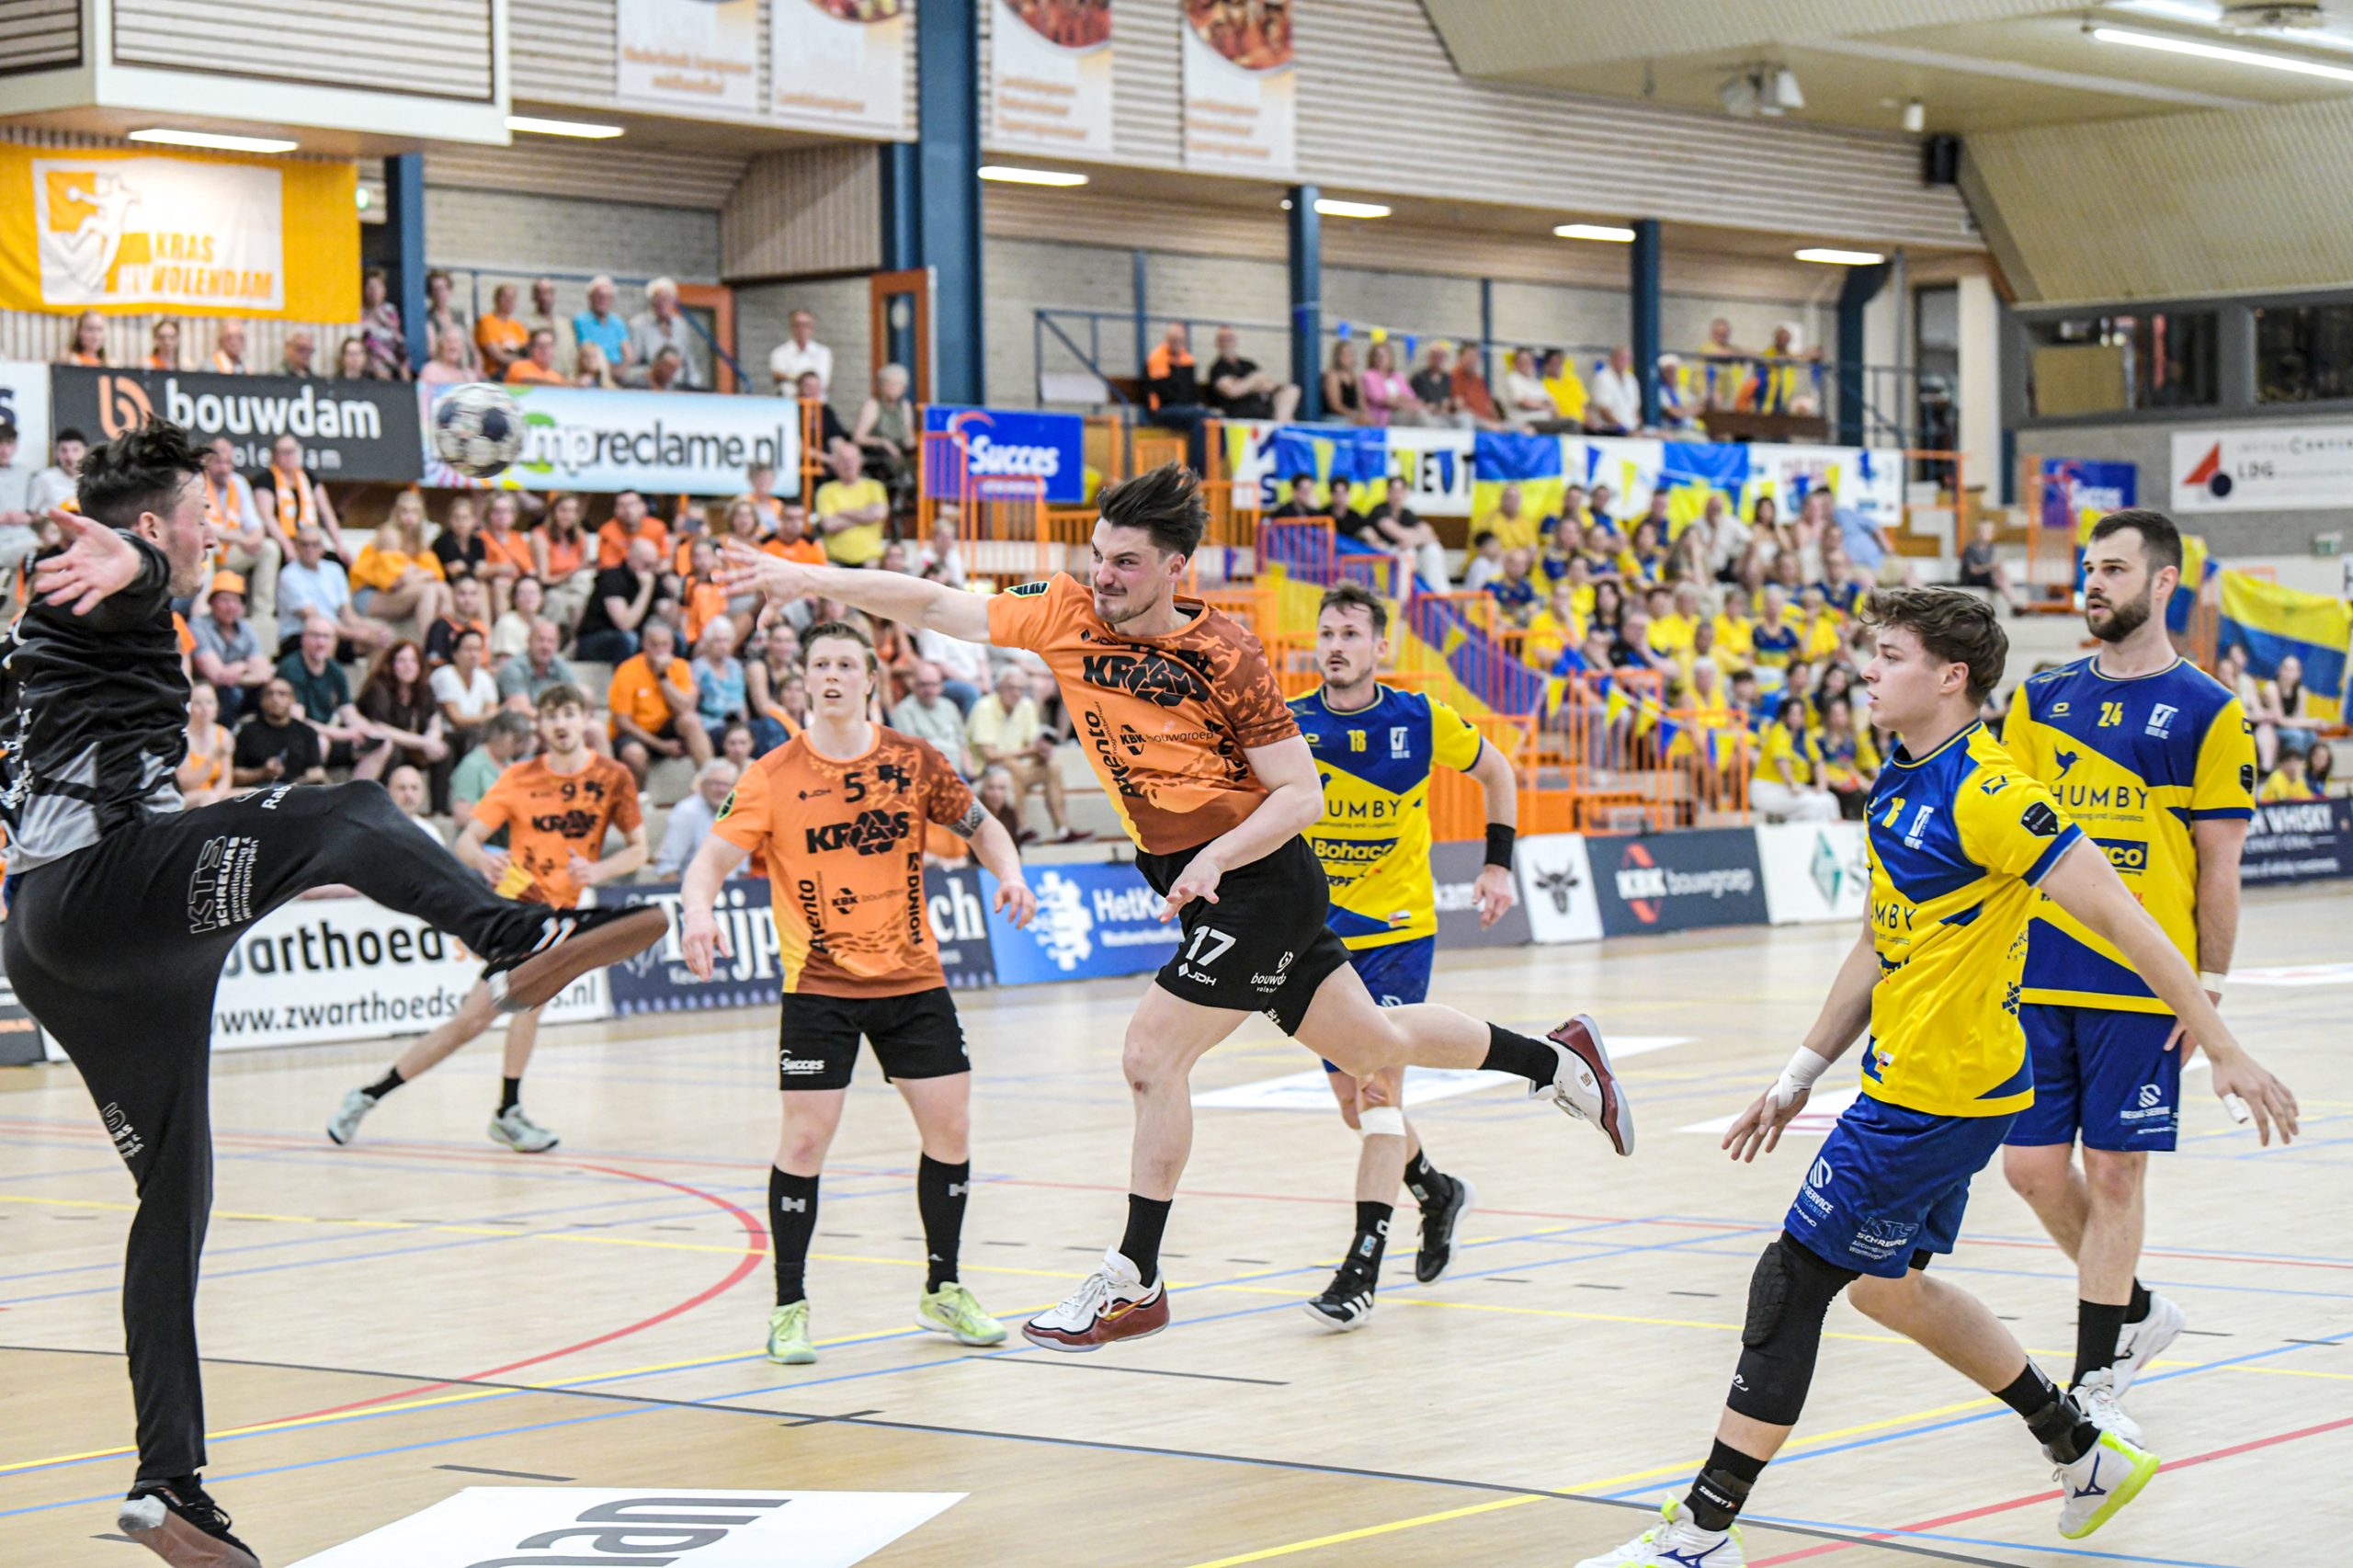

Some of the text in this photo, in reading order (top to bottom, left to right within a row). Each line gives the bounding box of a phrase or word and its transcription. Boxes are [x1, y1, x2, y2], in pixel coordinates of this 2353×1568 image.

[155, 232, 215, 263] KRAS
[152, 265, 273, 299] VOLENDAM
[165, 378, 382, 439] bouwdam
[969, 435, 1060, 477] Succes
[2097, 702, 2123, 727] 24
[1120, 734, 1146, 745] KBK
[261, 785, 292, 810] Rab
[844, 773, 866, 802] 5
[2050, 785, 2148, 809] HUMBY
[1328, 799, 1402, 818] UMBY
[806, 811, 909, 855] KRAS
[188, 835, 227, 934] KTS
[215, 836, 240, 927] SCHREURS
[832, 896, 858, 906] KBK
[644, 889, 781, 982] Tijp
[1186, 925, 1237, 967] 17
[1188, 971, 1217, 986] JDH
[1250, 972, 1287, 985] bouwd
[781, 1057, 824, 1072] Succes
[1805, 1187, 1835, 1214] SERVICE
[1861, 1217, 1919, 1238] KTS
